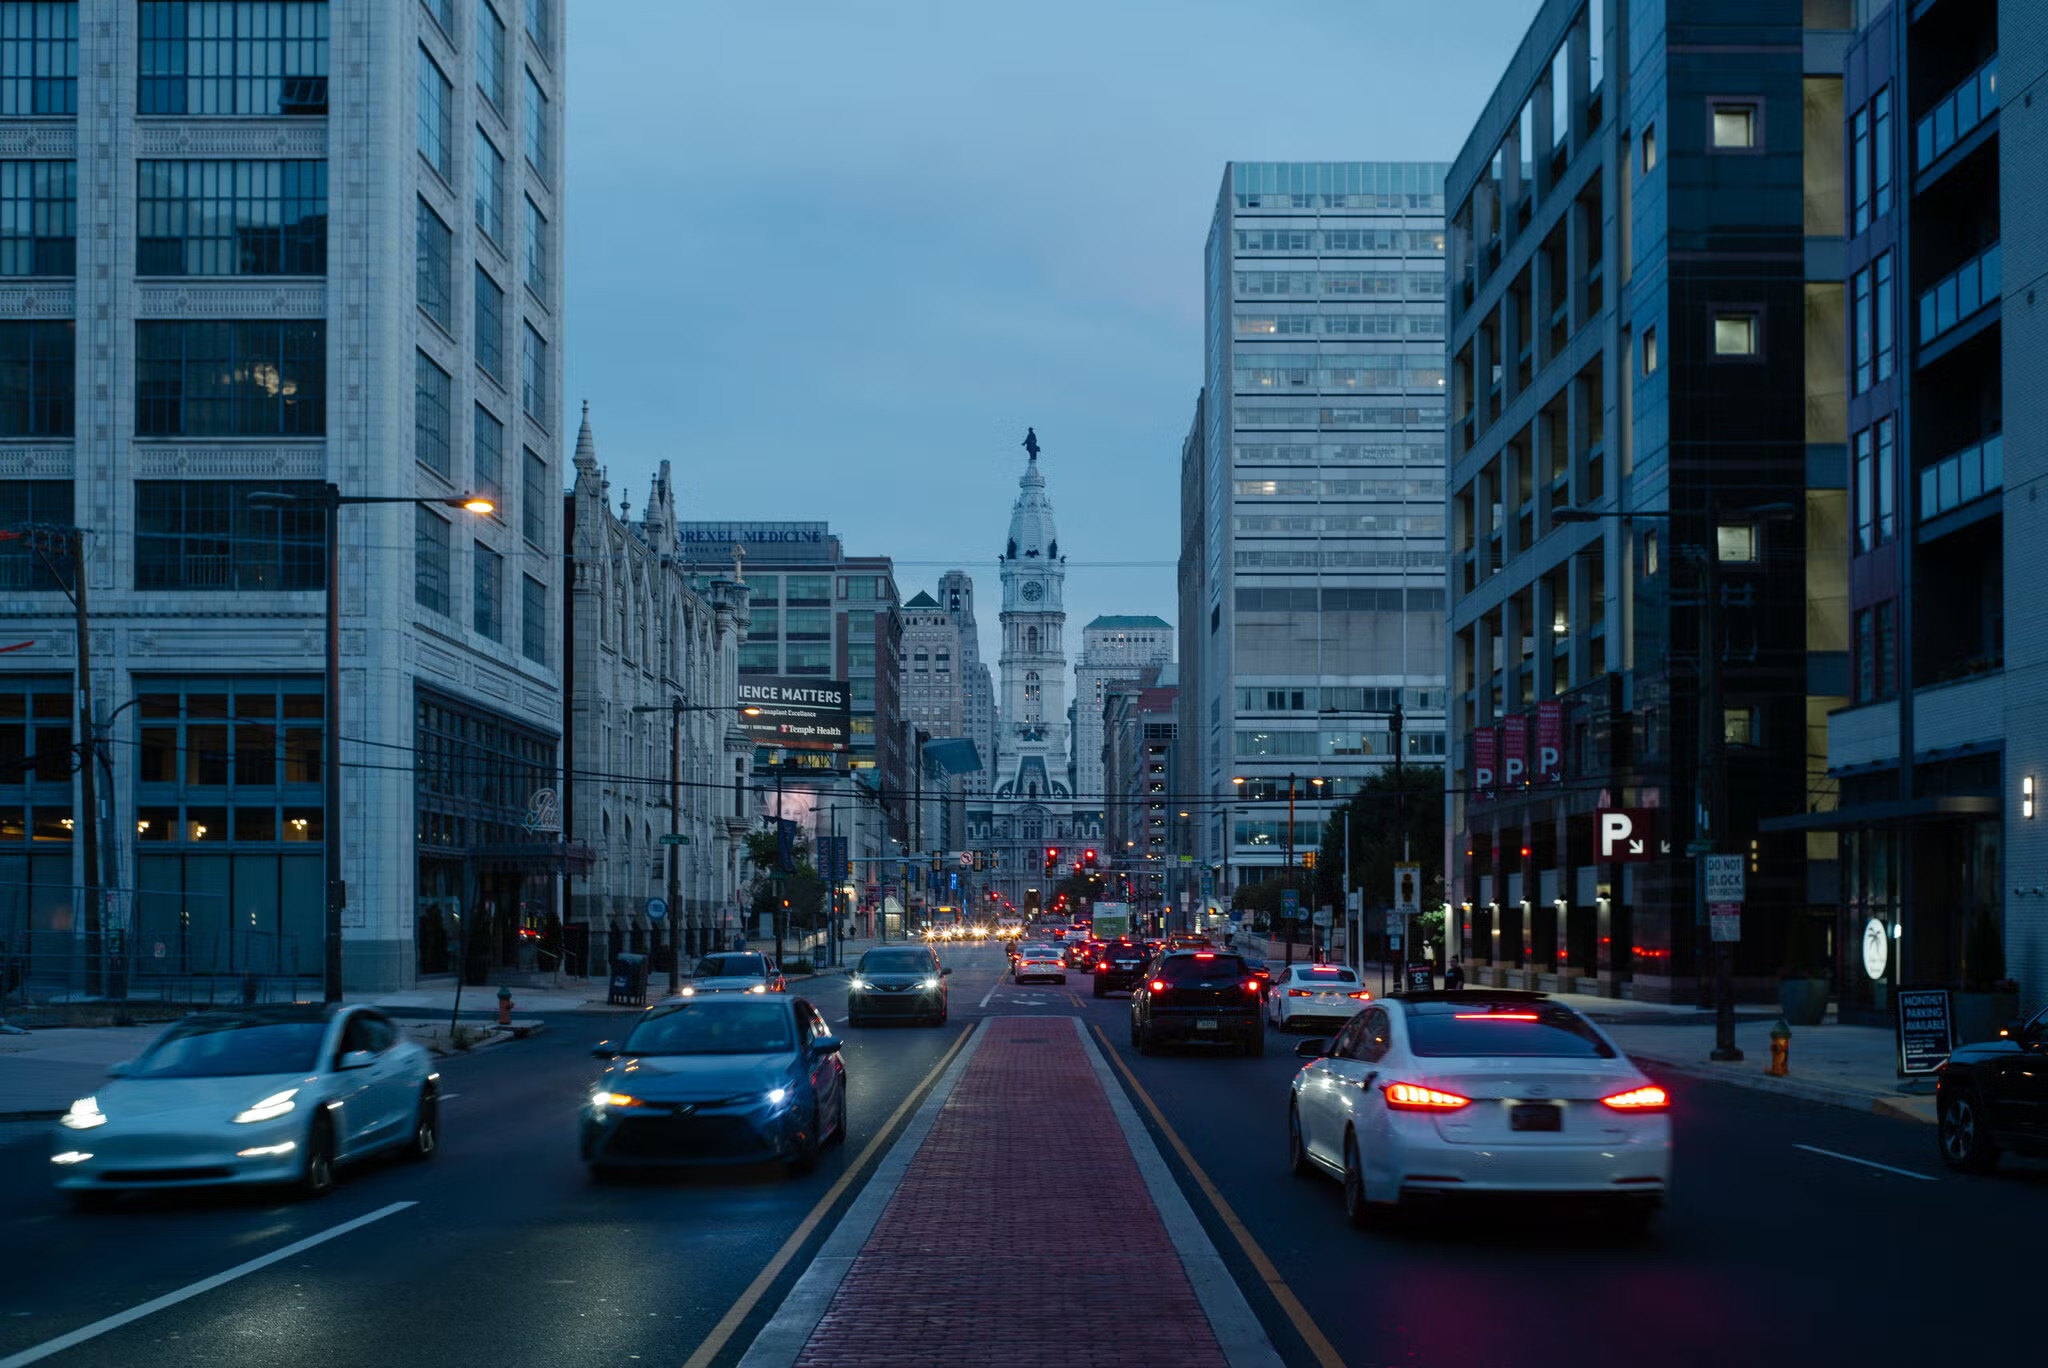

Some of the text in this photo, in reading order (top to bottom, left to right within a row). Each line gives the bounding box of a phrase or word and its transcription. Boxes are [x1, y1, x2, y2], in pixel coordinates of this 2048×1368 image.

[743, 530, 821, 543] MEDICINE
[781, 686, 842, 704] MATTERS
[788, 709, 817, 718] Excellence
[788, 725, 815, 736] Temple
[816, 725, 841, 736] Health
[1541, 747, 1559, 774] P
[1506, 758, 1523, 784] P
[1476, 768, 1493, 792] P
[1602, 813, 1632, 856] P
[1708, 859, 1741, 871] DO NOT
[1708, 874, 1742, 886] BLOCK
[1904, 994, 1944, 1006] MONTHLY
[1905, 1007, 1944, 1018] PARKING
[1905, 1019, 1947, 1031] AVAILABLE
